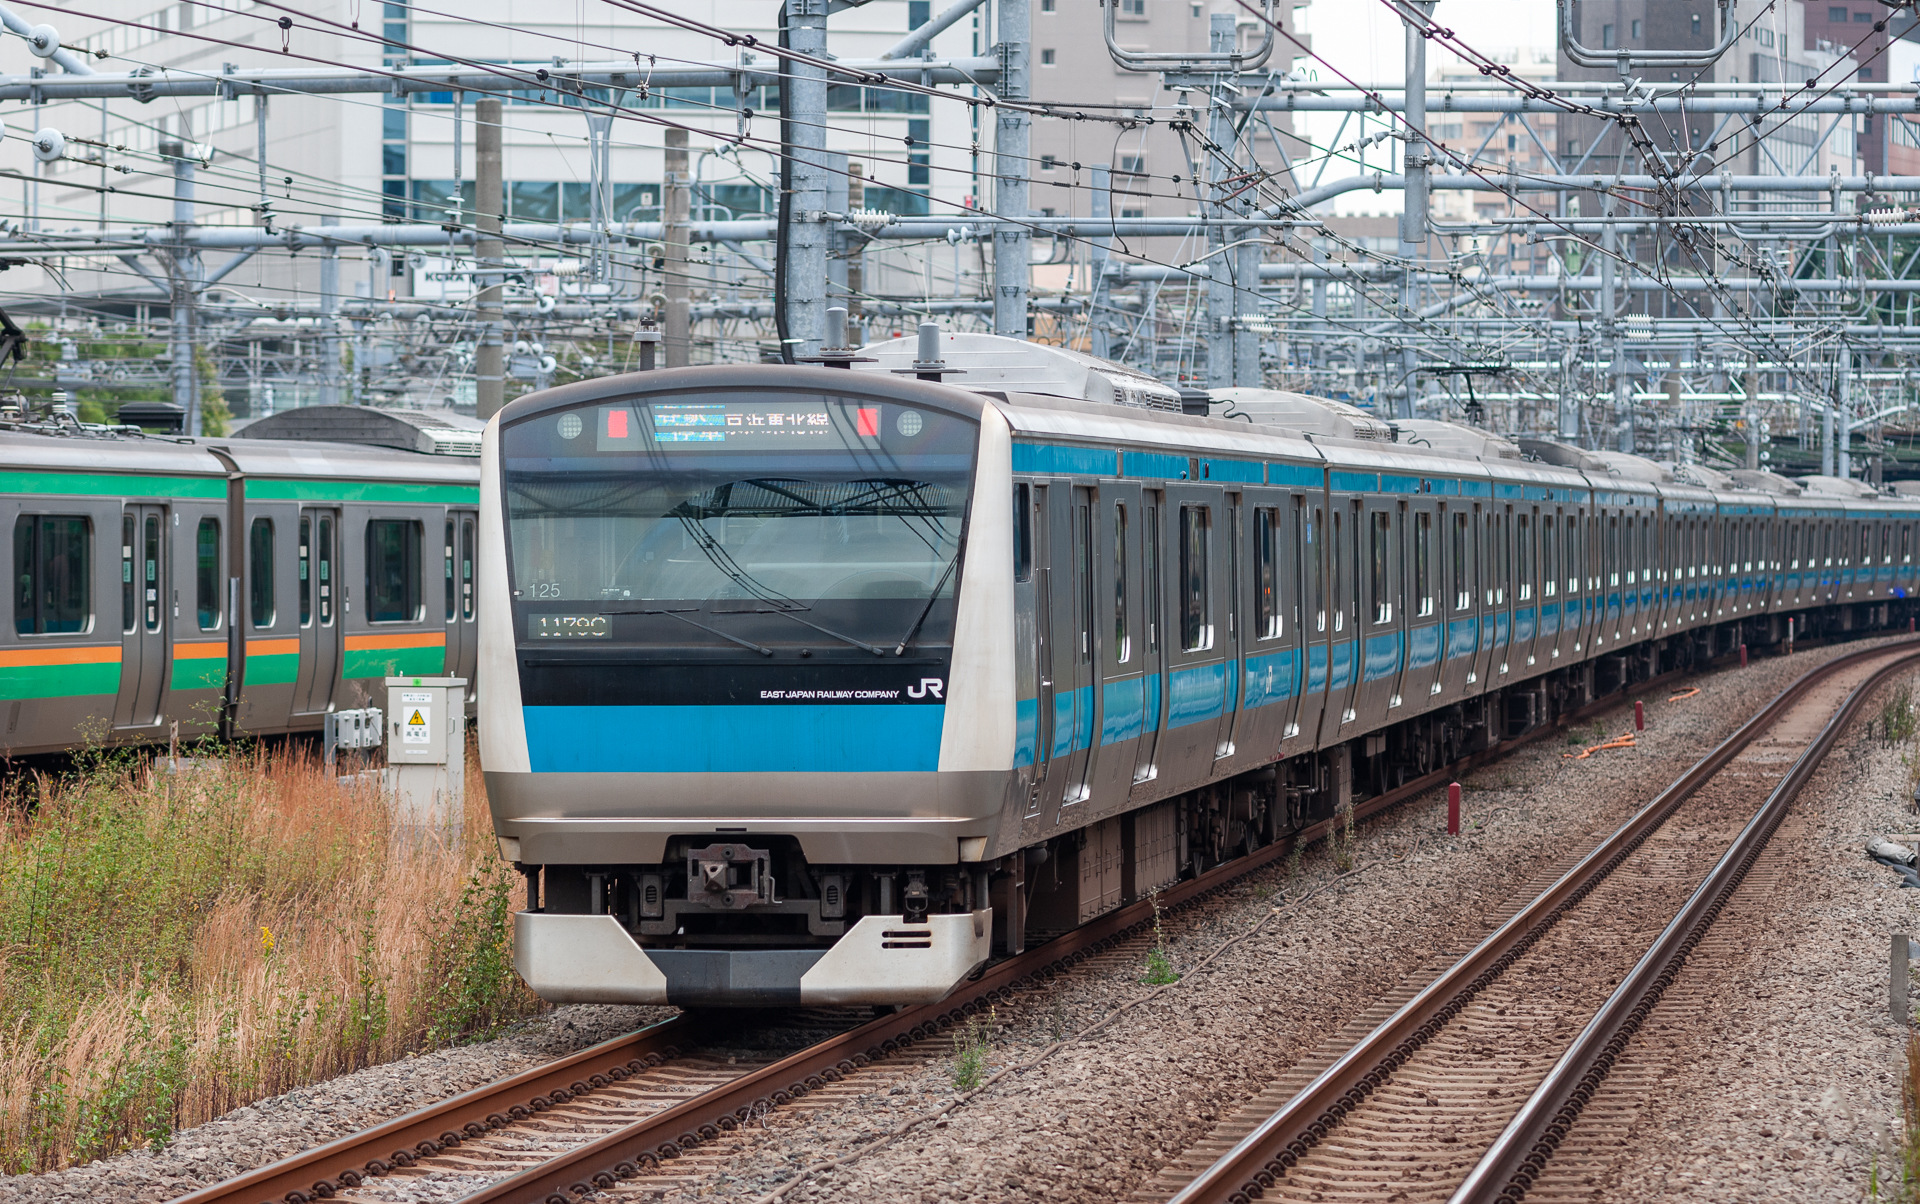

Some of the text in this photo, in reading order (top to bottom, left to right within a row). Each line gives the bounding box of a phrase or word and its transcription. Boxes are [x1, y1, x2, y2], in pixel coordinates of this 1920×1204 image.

[529, 583, 561, 598] 125
[760, 690, 900, 699] EAST JAPAN RAILWAY COMPANY
[907, 678, 944, 699] JR
